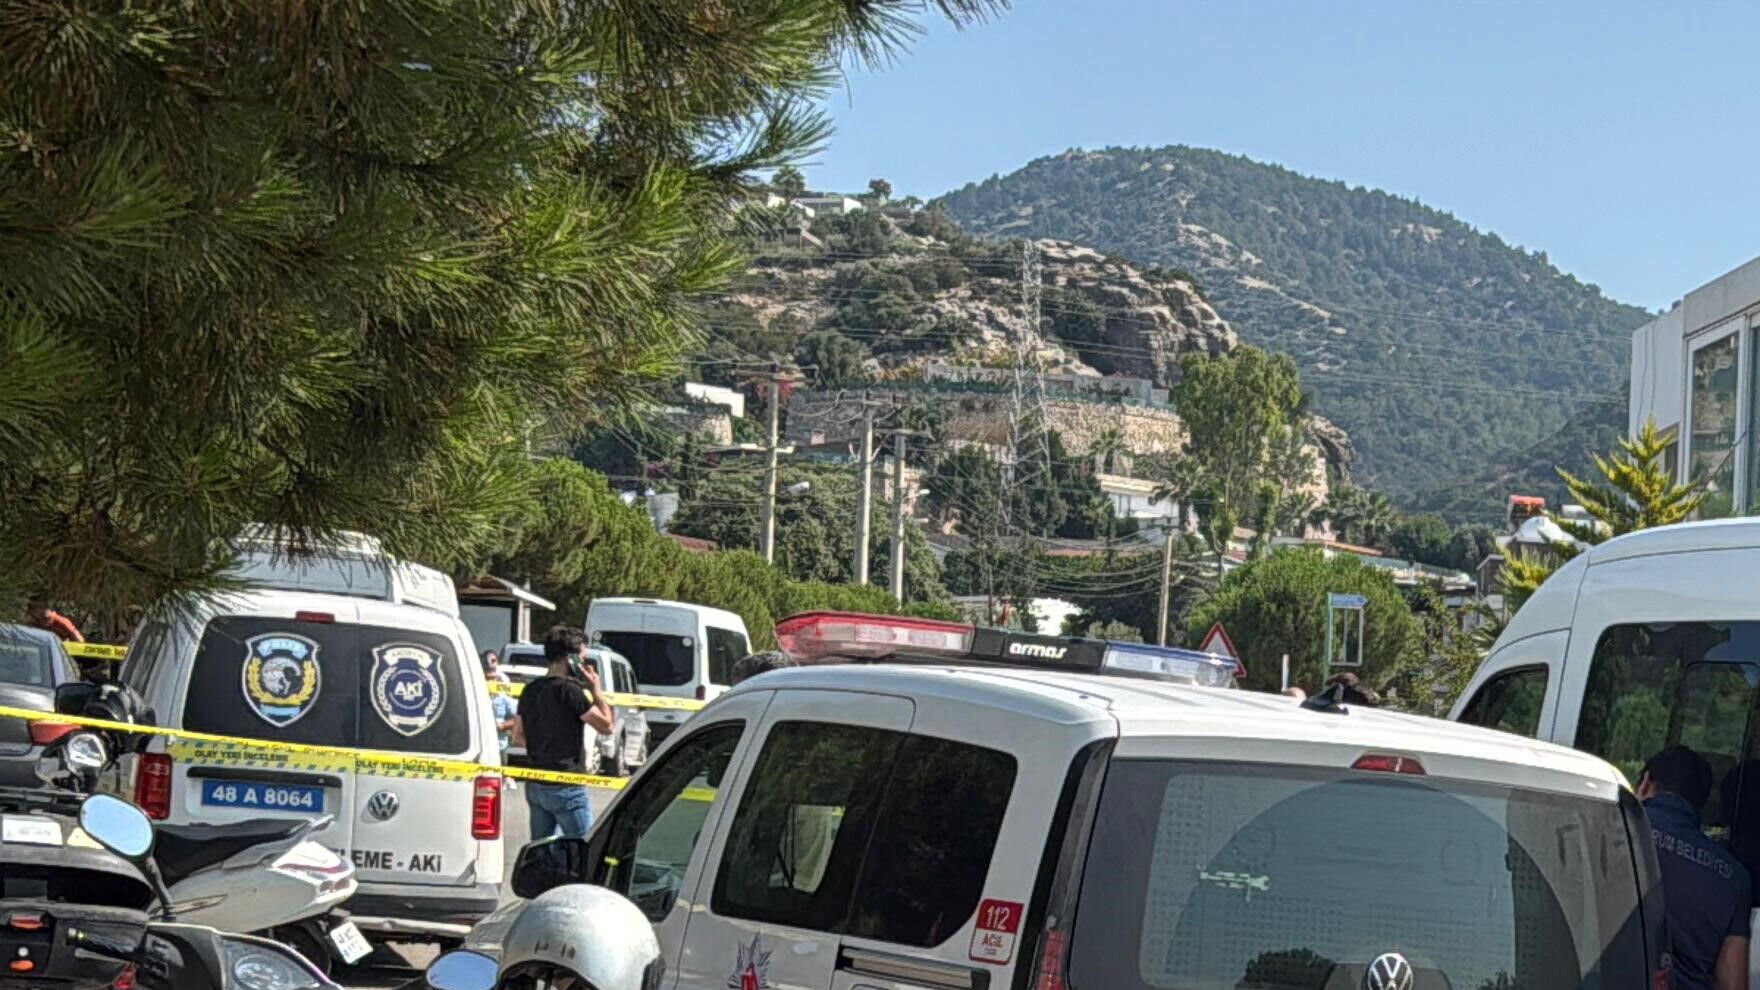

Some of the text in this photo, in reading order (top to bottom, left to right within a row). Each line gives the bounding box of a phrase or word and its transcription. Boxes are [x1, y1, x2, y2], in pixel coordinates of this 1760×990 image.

[1009, 642, 1068, 659] armas
[212, 785, 313, 807] 48 A 8064
[409, 854, 442, 873] AKİ
[986, 905, 1010, 930] 112
